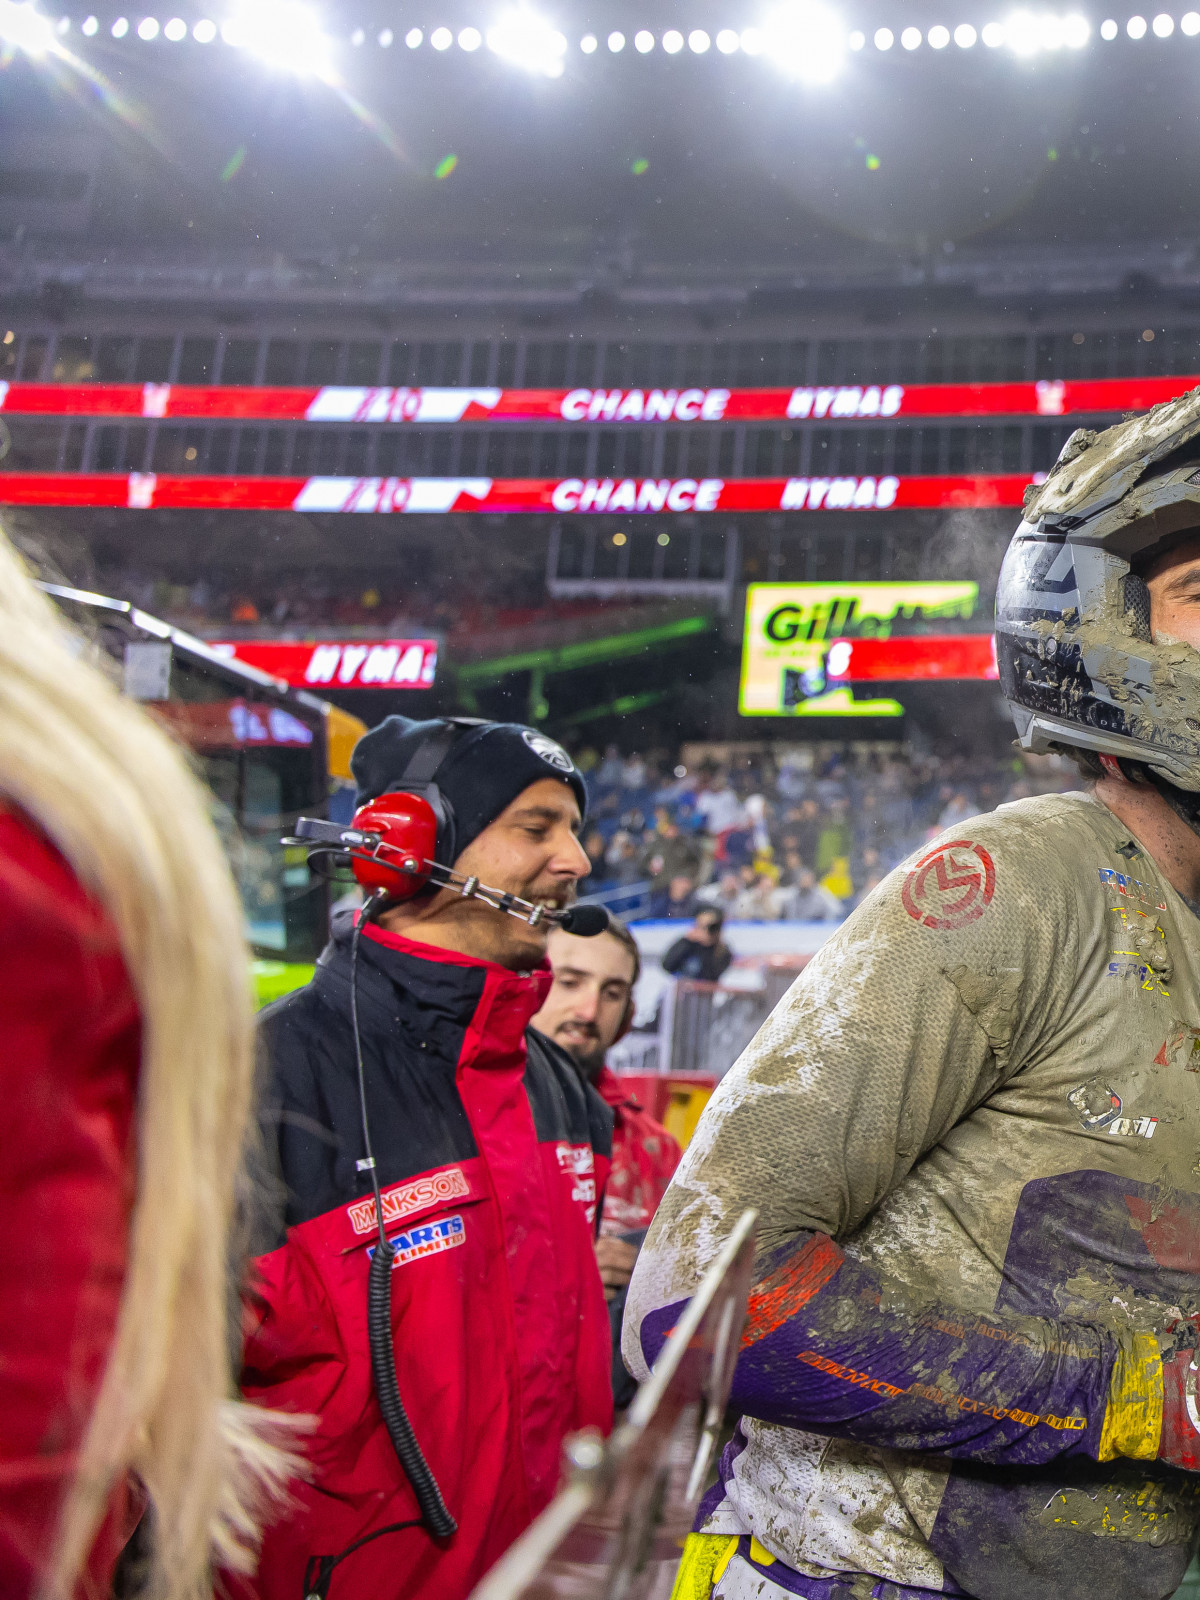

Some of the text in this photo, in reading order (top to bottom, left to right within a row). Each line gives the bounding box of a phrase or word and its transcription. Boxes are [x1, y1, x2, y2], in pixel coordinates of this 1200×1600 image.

[561, 385, 903, 421] CHANCE HYMAS
[552, 476, 900, 511] CHANCE HYMAS
